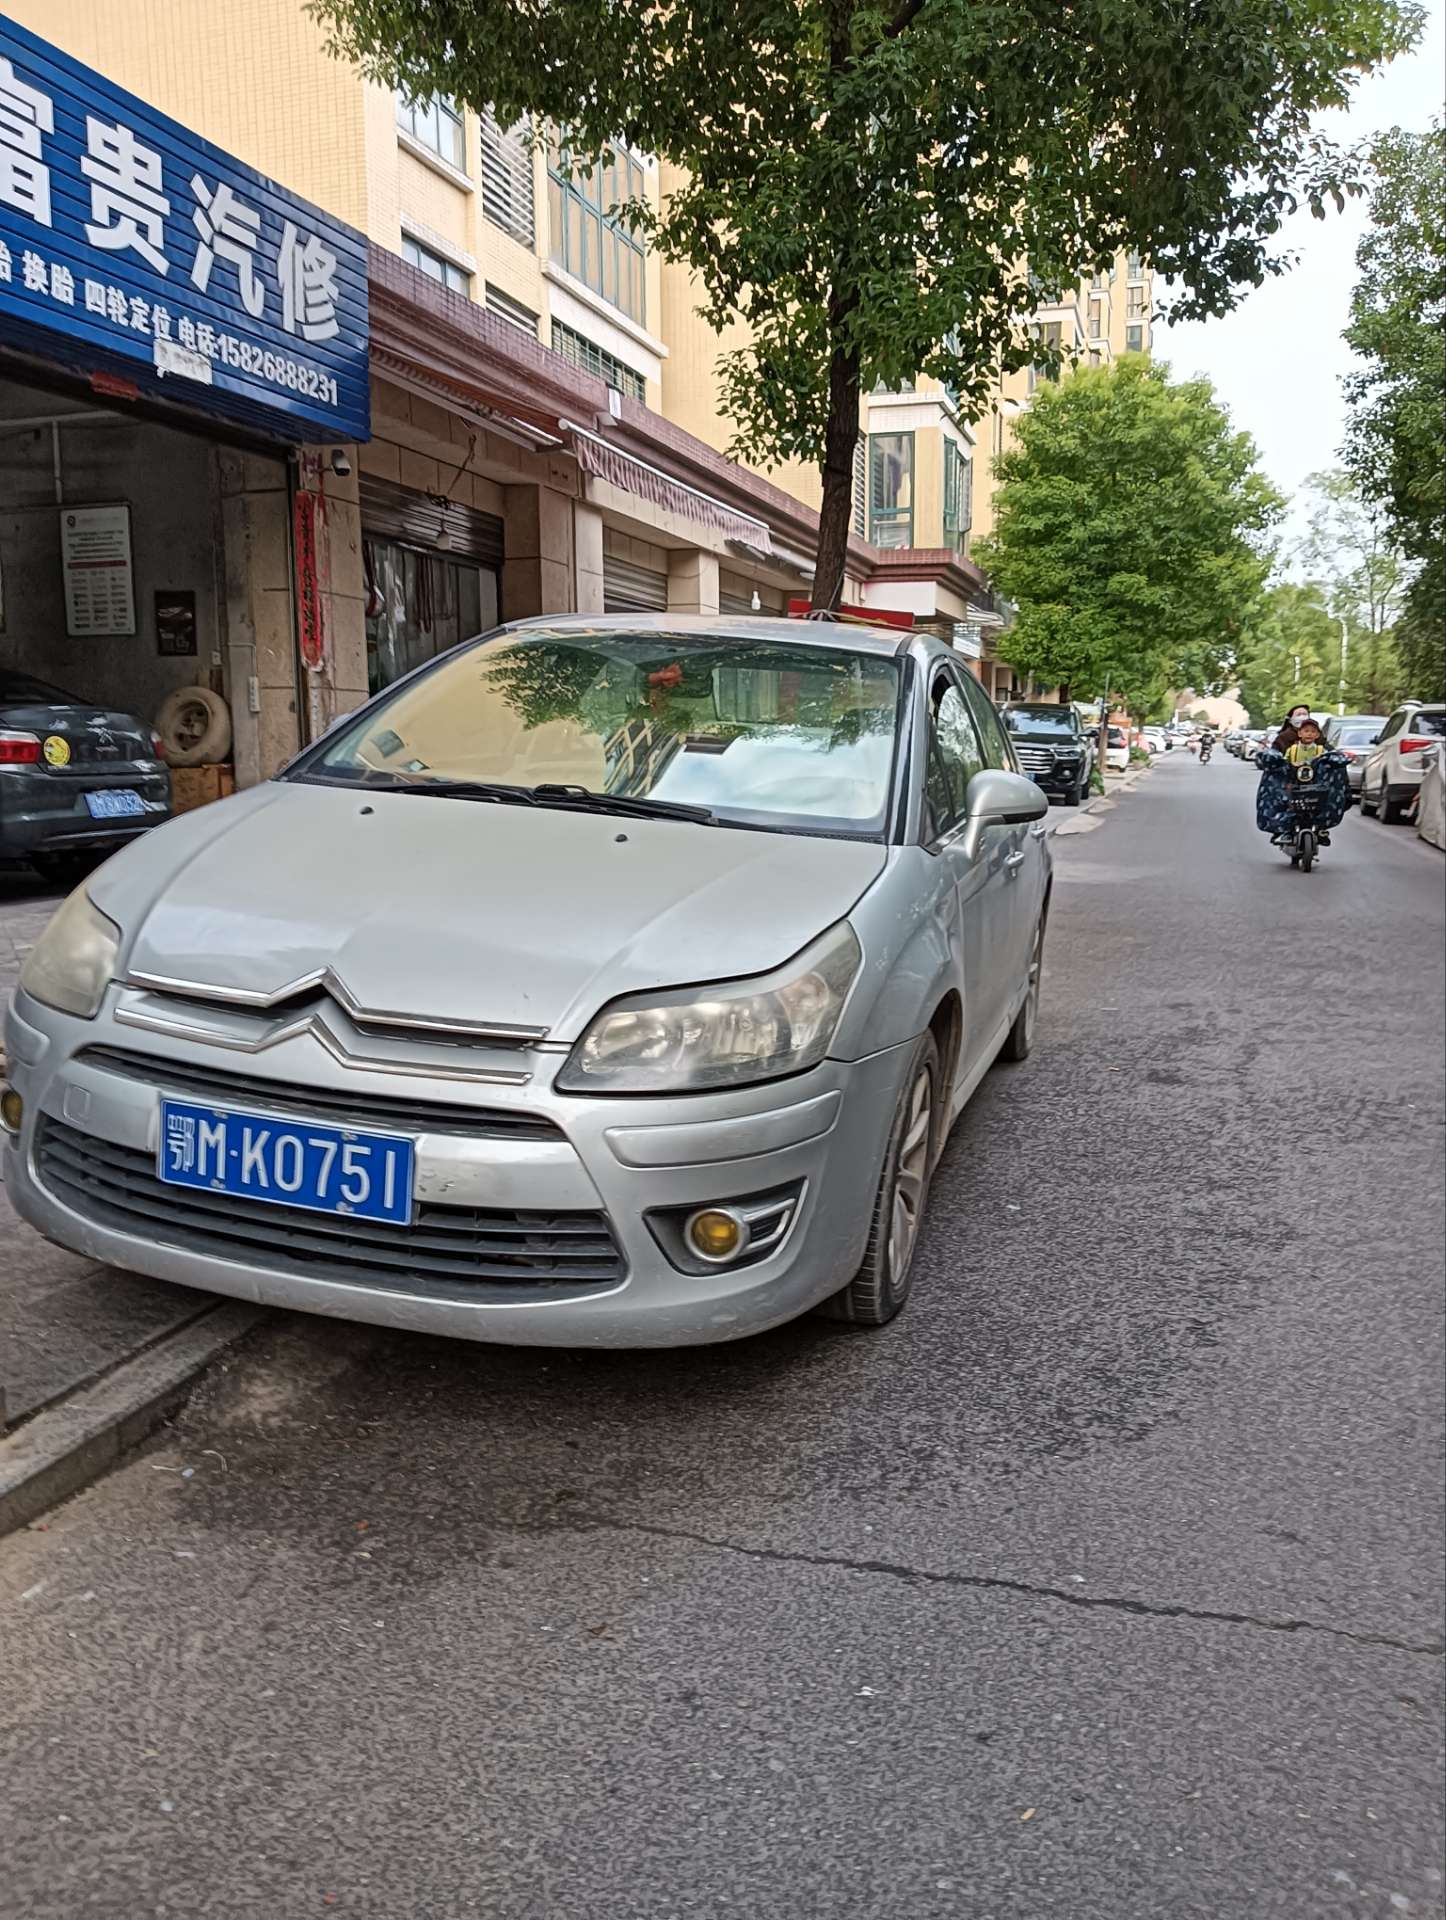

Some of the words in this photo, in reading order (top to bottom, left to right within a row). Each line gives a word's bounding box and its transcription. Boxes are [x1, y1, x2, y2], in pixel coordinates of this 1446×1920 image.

[22, 250, 75, 306] 换胎
[84, 278, 172, 341] 四轮定位
